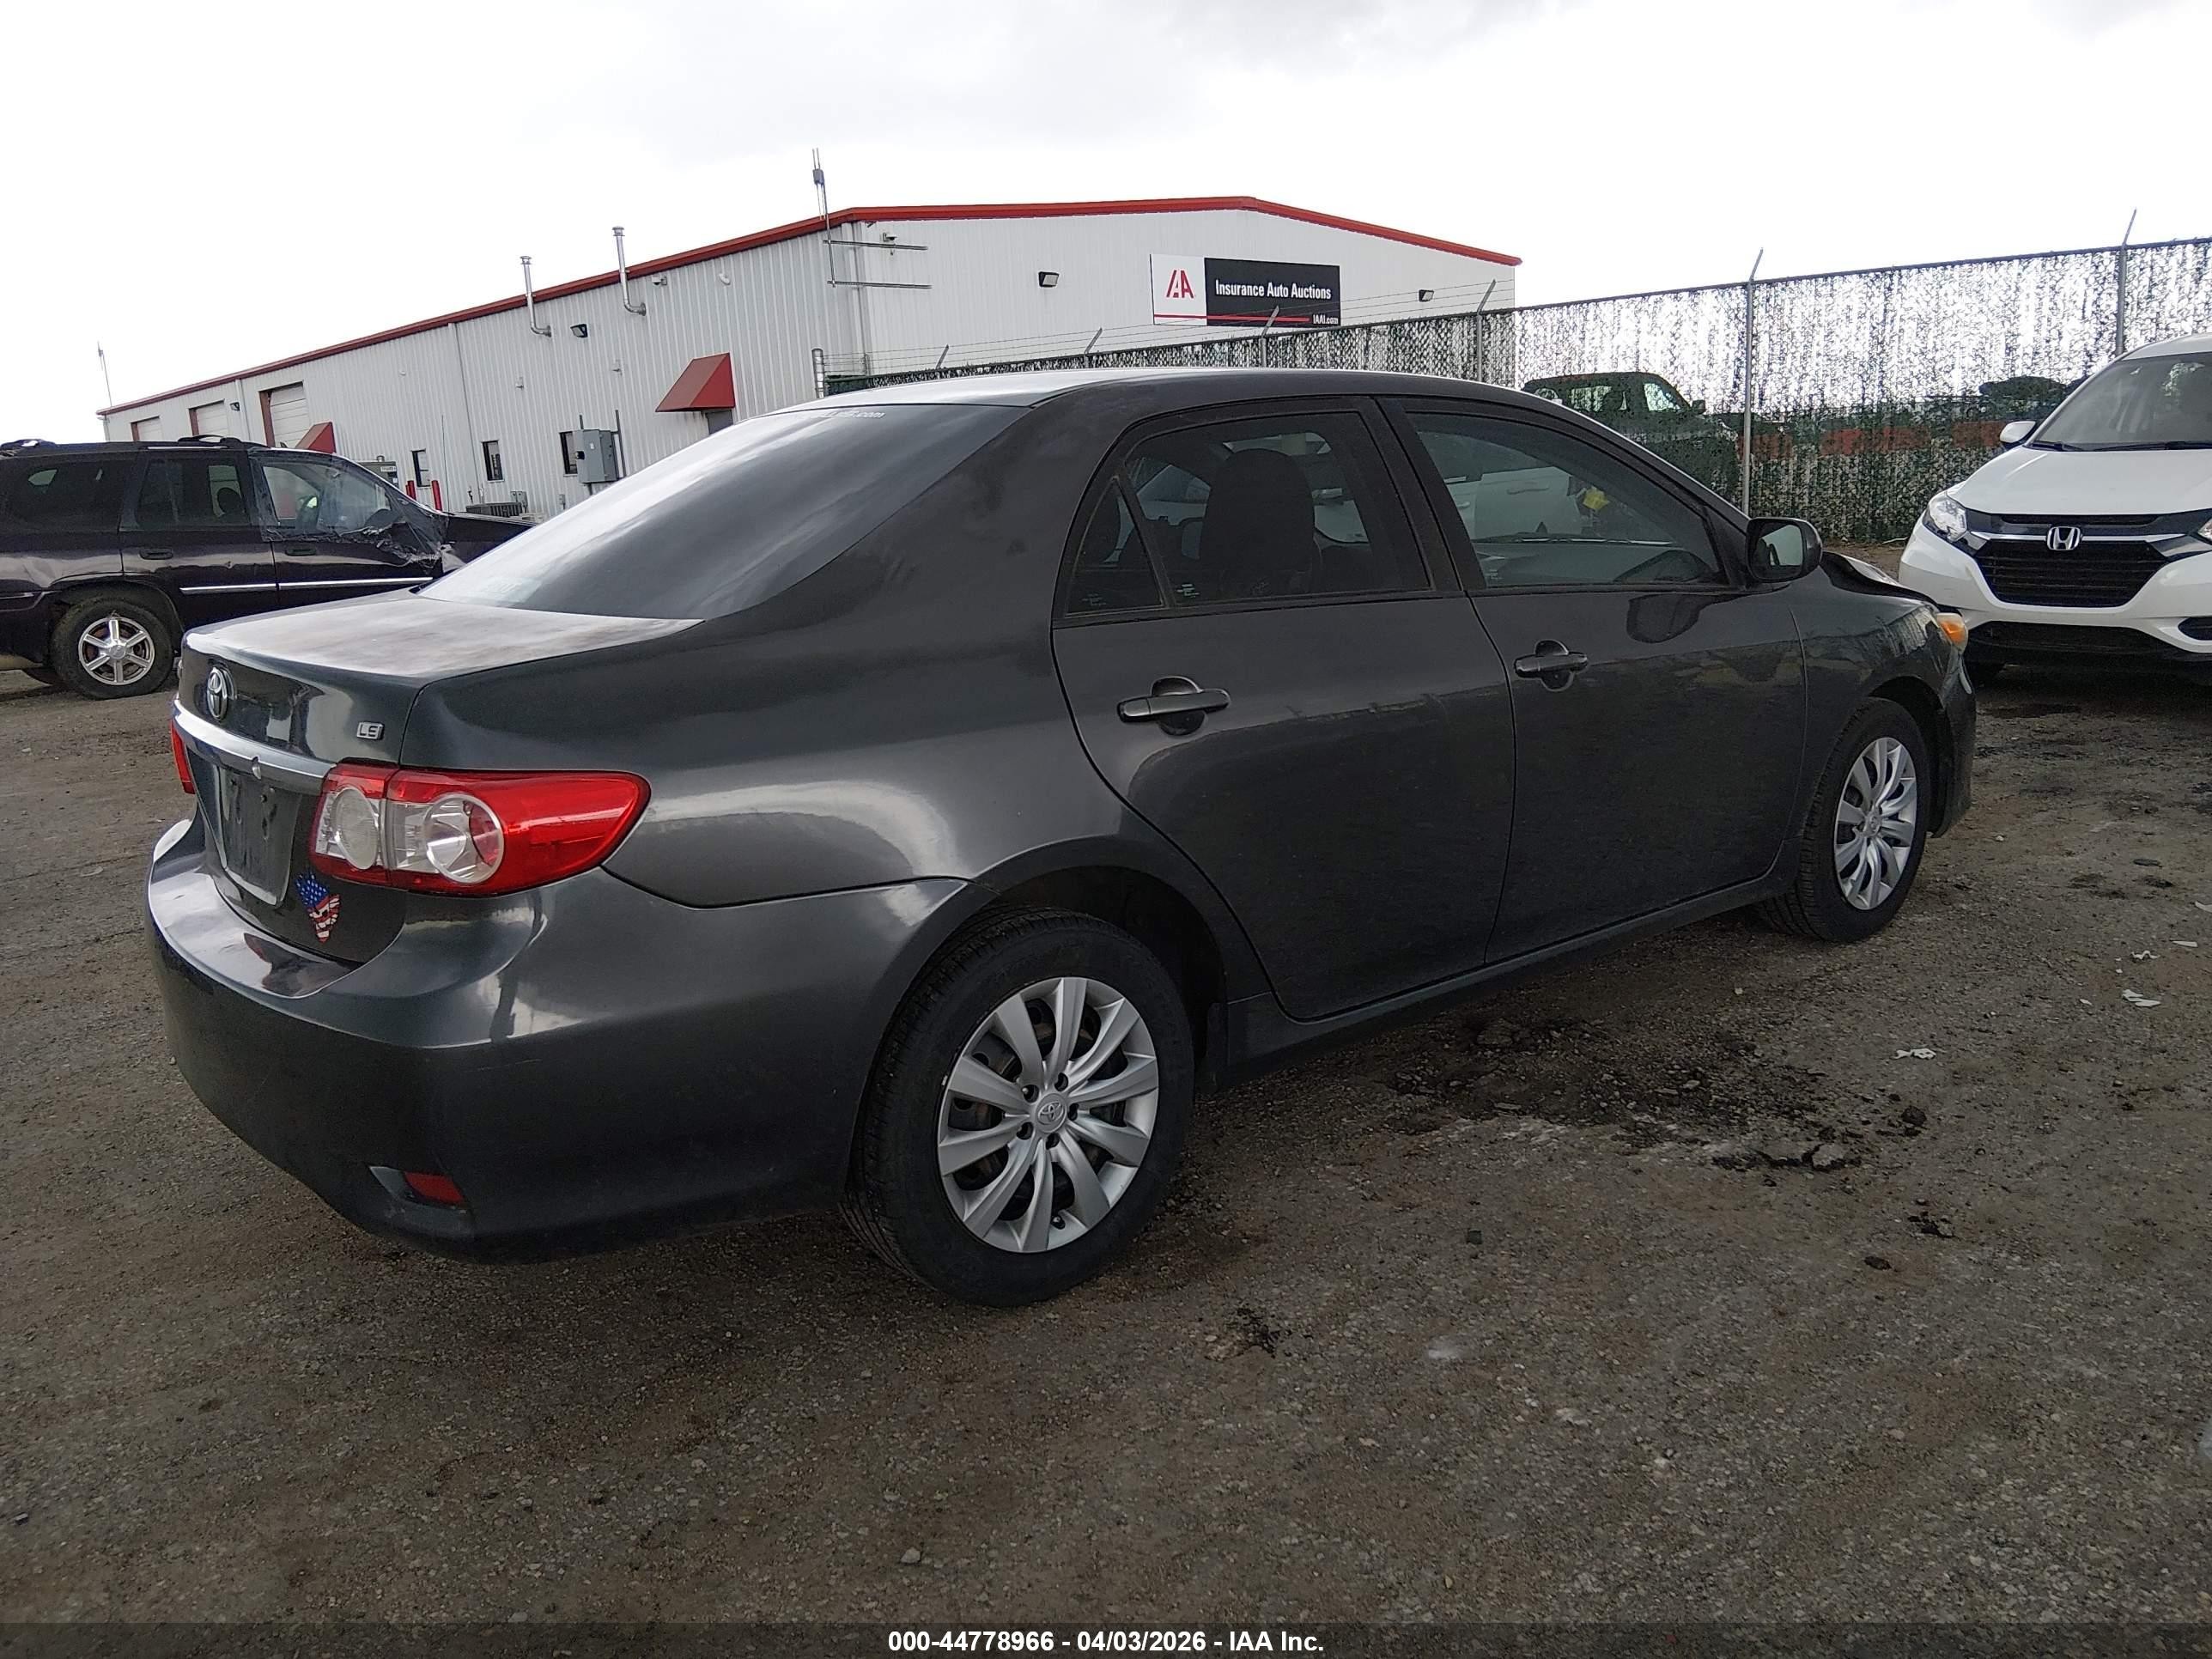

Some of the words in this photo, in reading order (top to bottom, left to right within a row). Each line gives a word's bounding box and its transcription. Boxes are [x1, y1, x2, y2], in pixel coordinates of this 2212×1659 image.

[1215, 279, 1264, 297] Insurance
[1267, 282, 1289, 299] Auto
[1291, 284, 1331, 300] Auctions
[1313, 314, 1339, 325] IAAI.com
[359, 723, 380, 738] LE
